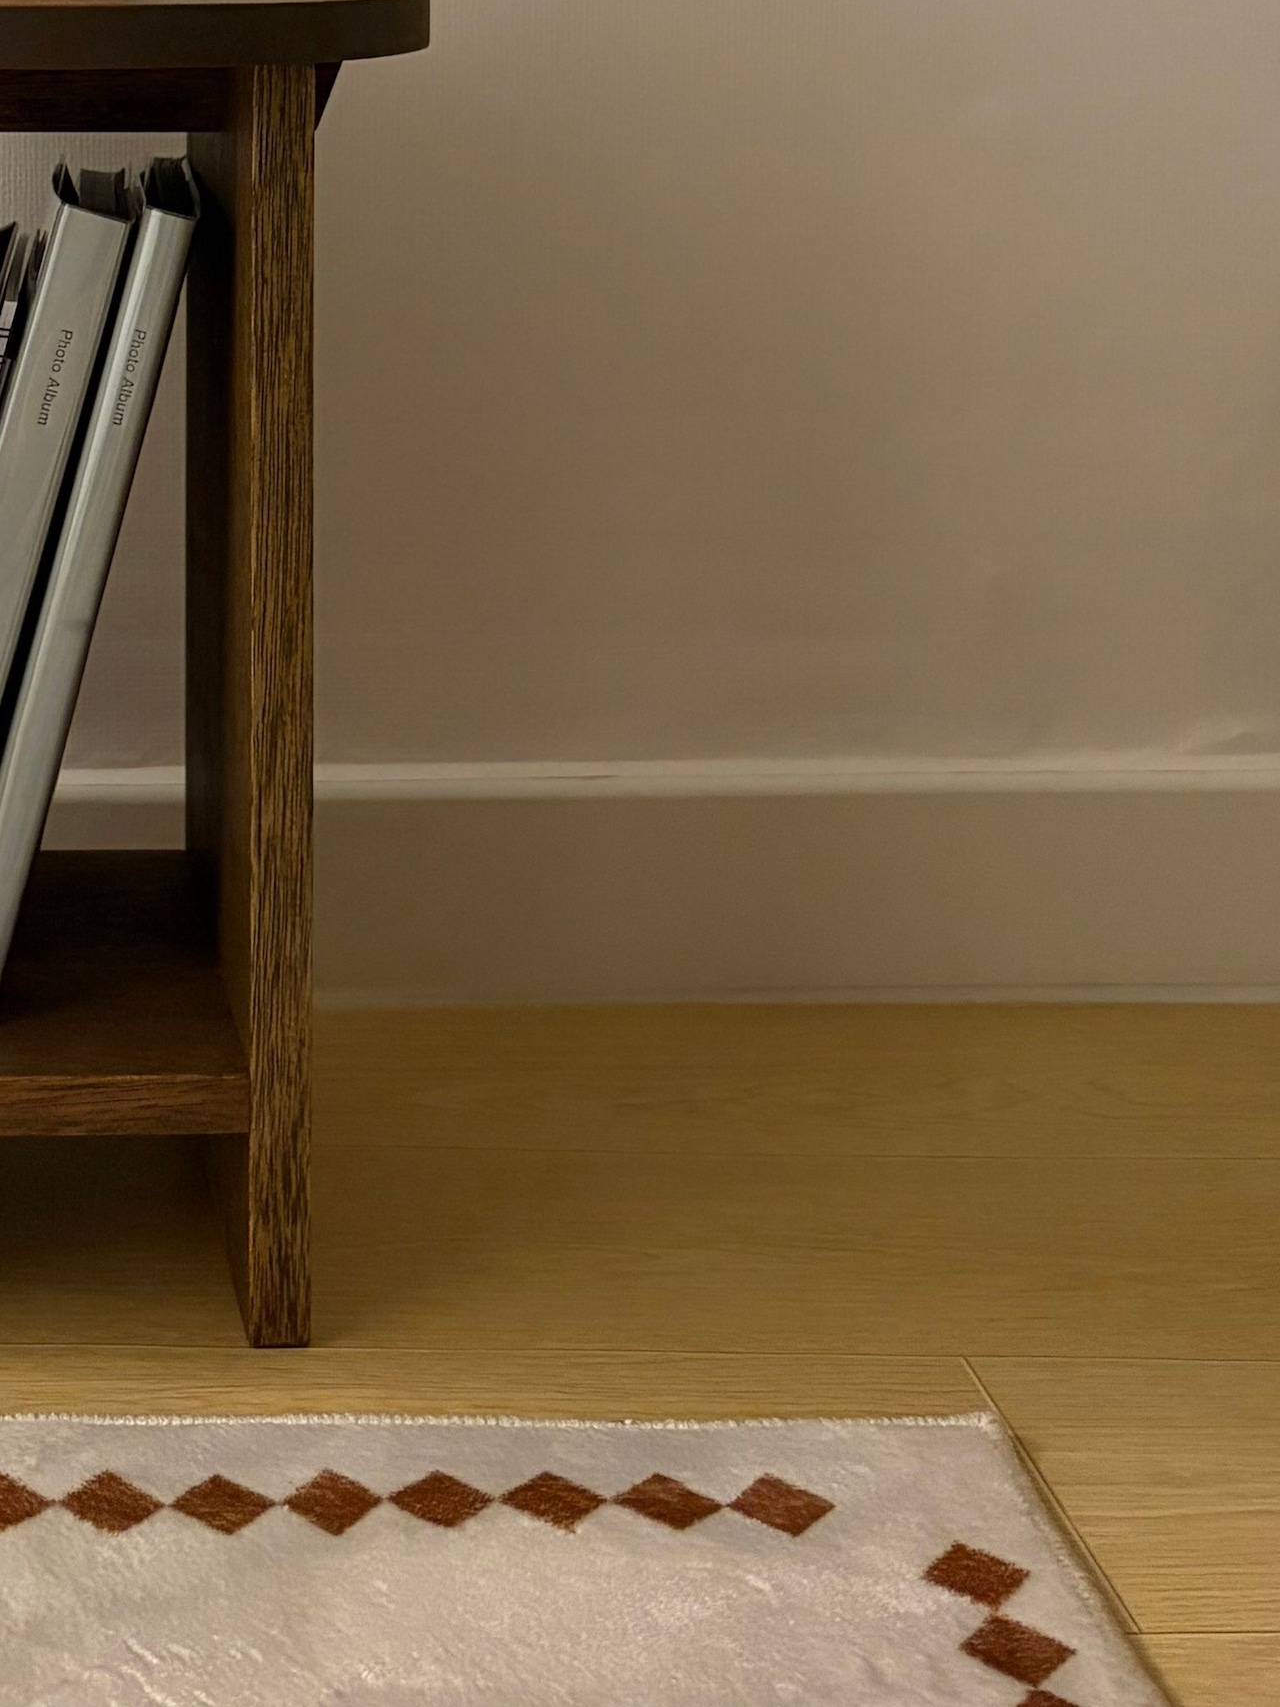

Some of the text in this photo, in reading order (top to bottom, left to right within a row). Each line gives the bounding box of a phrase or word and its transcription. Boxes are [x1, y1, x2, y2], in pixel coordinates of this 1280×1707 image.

[37, 329, 73, 426] Photo Album
[112, 329, 147, 426] Photo Album
